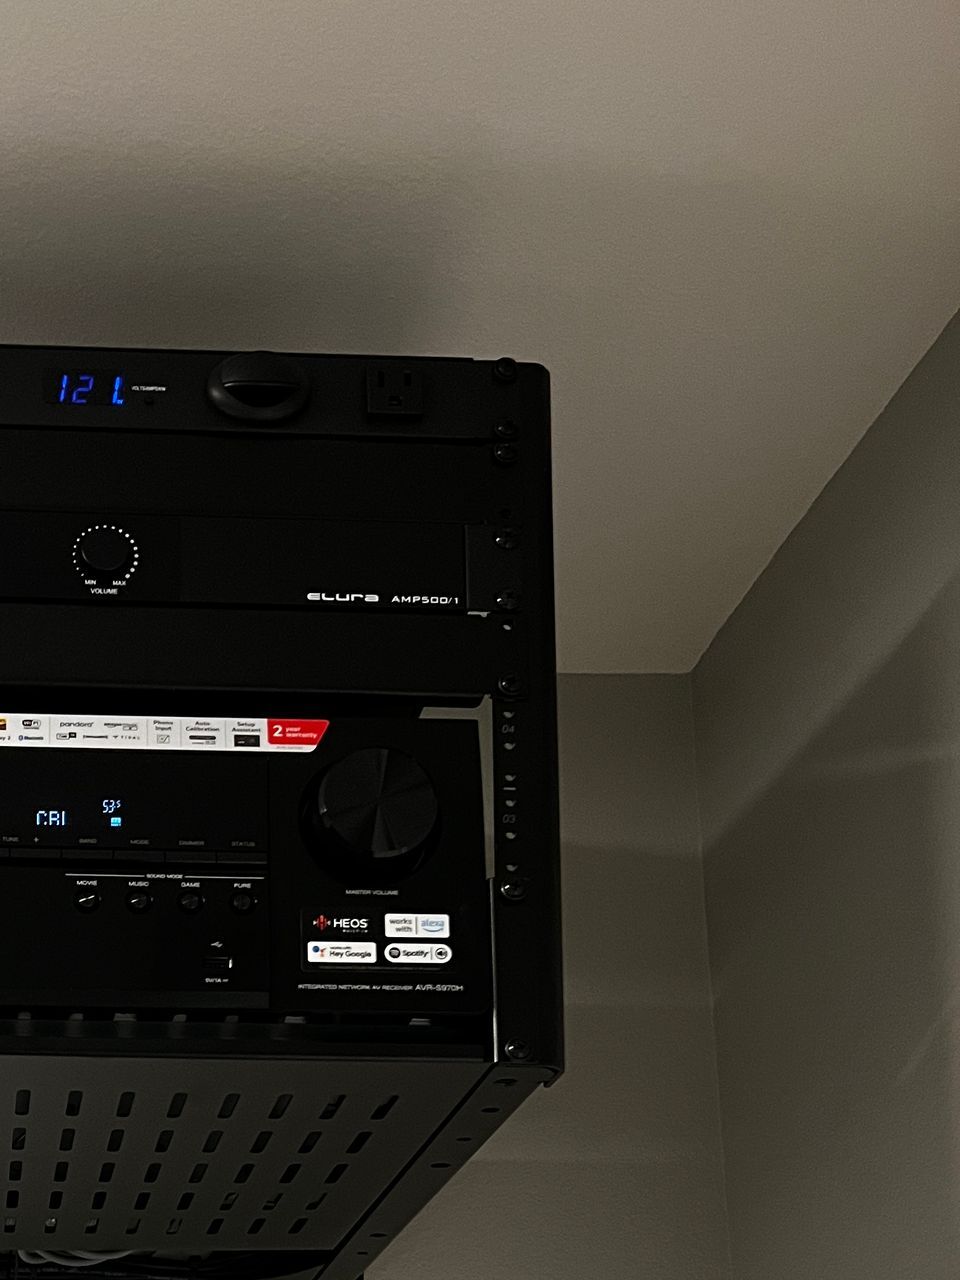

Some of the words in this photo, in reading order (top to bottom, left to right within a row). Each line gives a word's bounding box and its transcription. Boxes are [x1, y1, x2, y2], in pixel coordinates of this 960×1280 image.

[392, 595, 459, 604] AMP500/1
[272, 725, 283, 737] 2
[502, 725, 515, 733] 04
[502, 814, 515, 823] 03
[334, 918, 368, 928] HEOS
